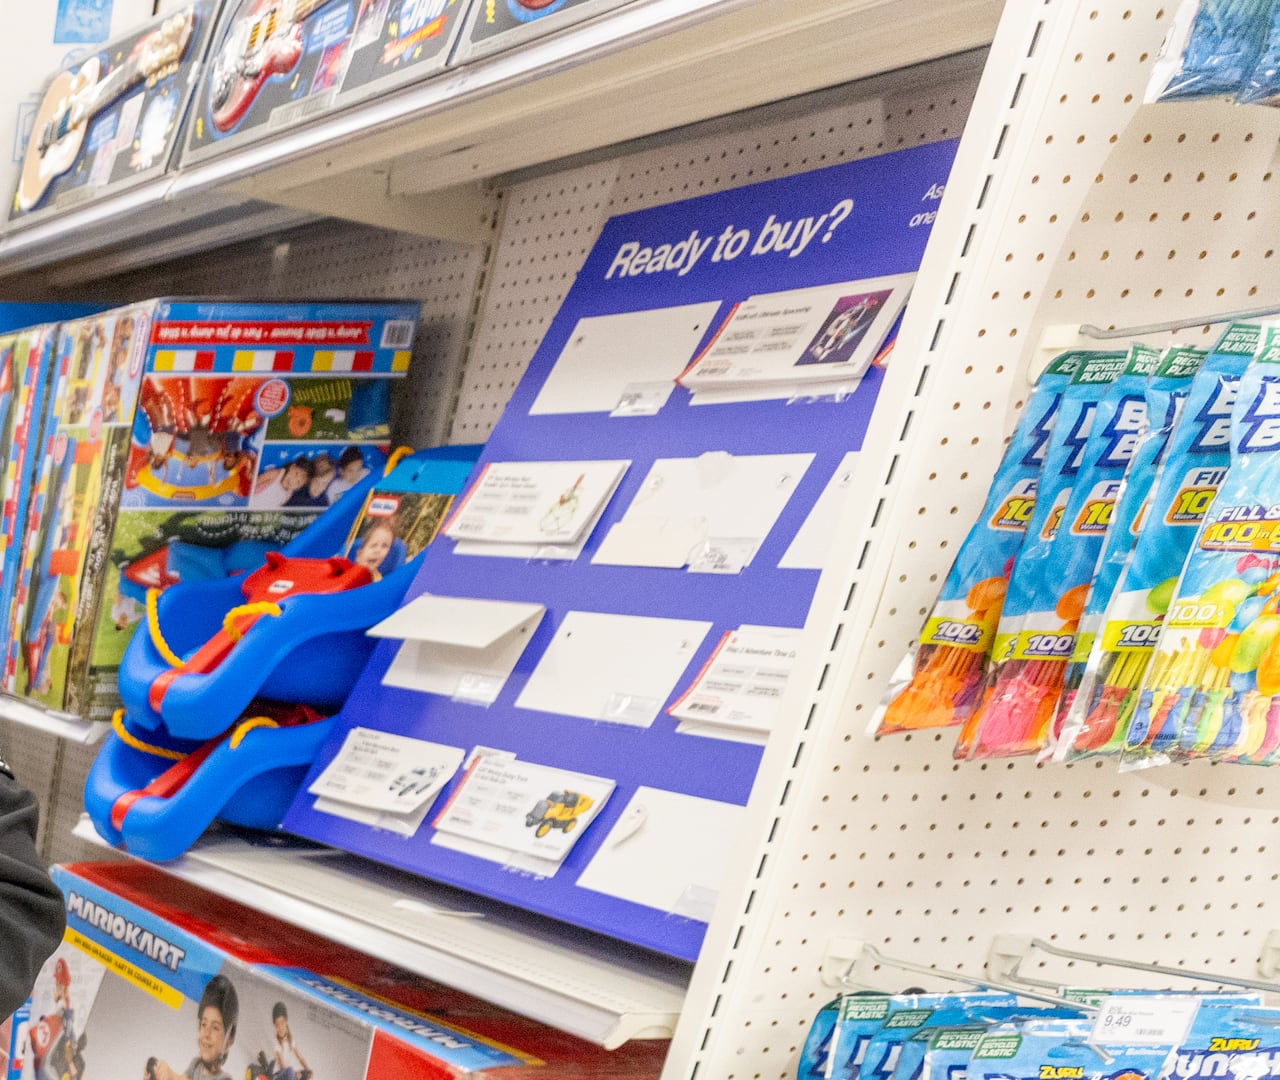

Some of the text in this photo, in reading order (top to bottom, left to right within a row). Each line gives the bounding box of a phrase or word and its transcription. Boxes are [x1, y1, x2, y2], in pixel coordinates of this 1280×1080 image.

[604, 199, 854, 280] Ready to buy?
[1218, 506, 1264, 521] FILL
[1208, 524, 1258, 543] 100
[1104, 1015, 1132, 1028] 9.49
[1208, 1037, 1262, 1052] ZURU
